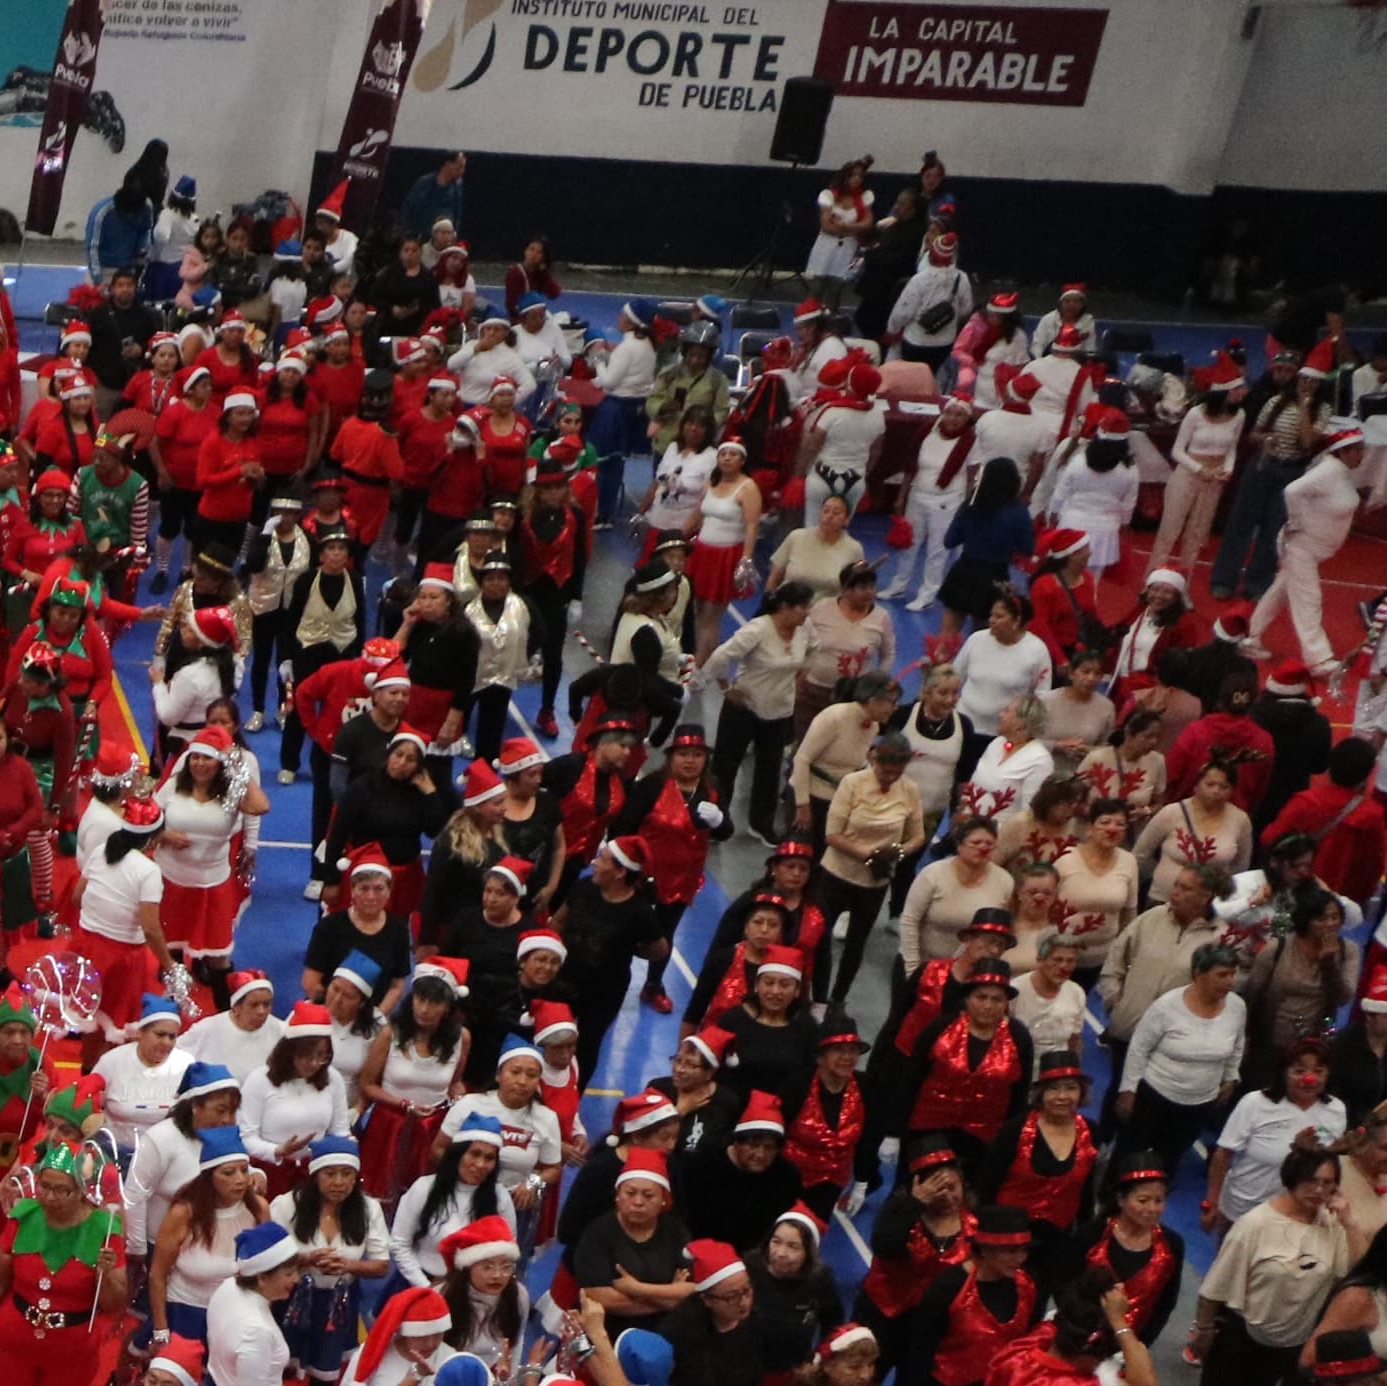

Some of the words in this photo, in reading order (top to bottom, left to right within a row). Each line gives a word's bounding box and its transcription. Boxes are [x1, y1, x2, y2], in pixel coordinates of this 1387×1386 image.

[511, 0, 607, 18] INSTITUTO
[613, 2, 710, 24] MUNICIPAL
[723, 7, 759, 26] DEL
[868, 16, 900, 39] LA
[918, 17, 1019, 45] CAPITAL
[523, 24, 786, 82] DEPORTE
[842, 45, 1076, 93] IMPARABLE
[638, 82, 672, 108] DE
[682, 83, 777, 112] PUEBLA
